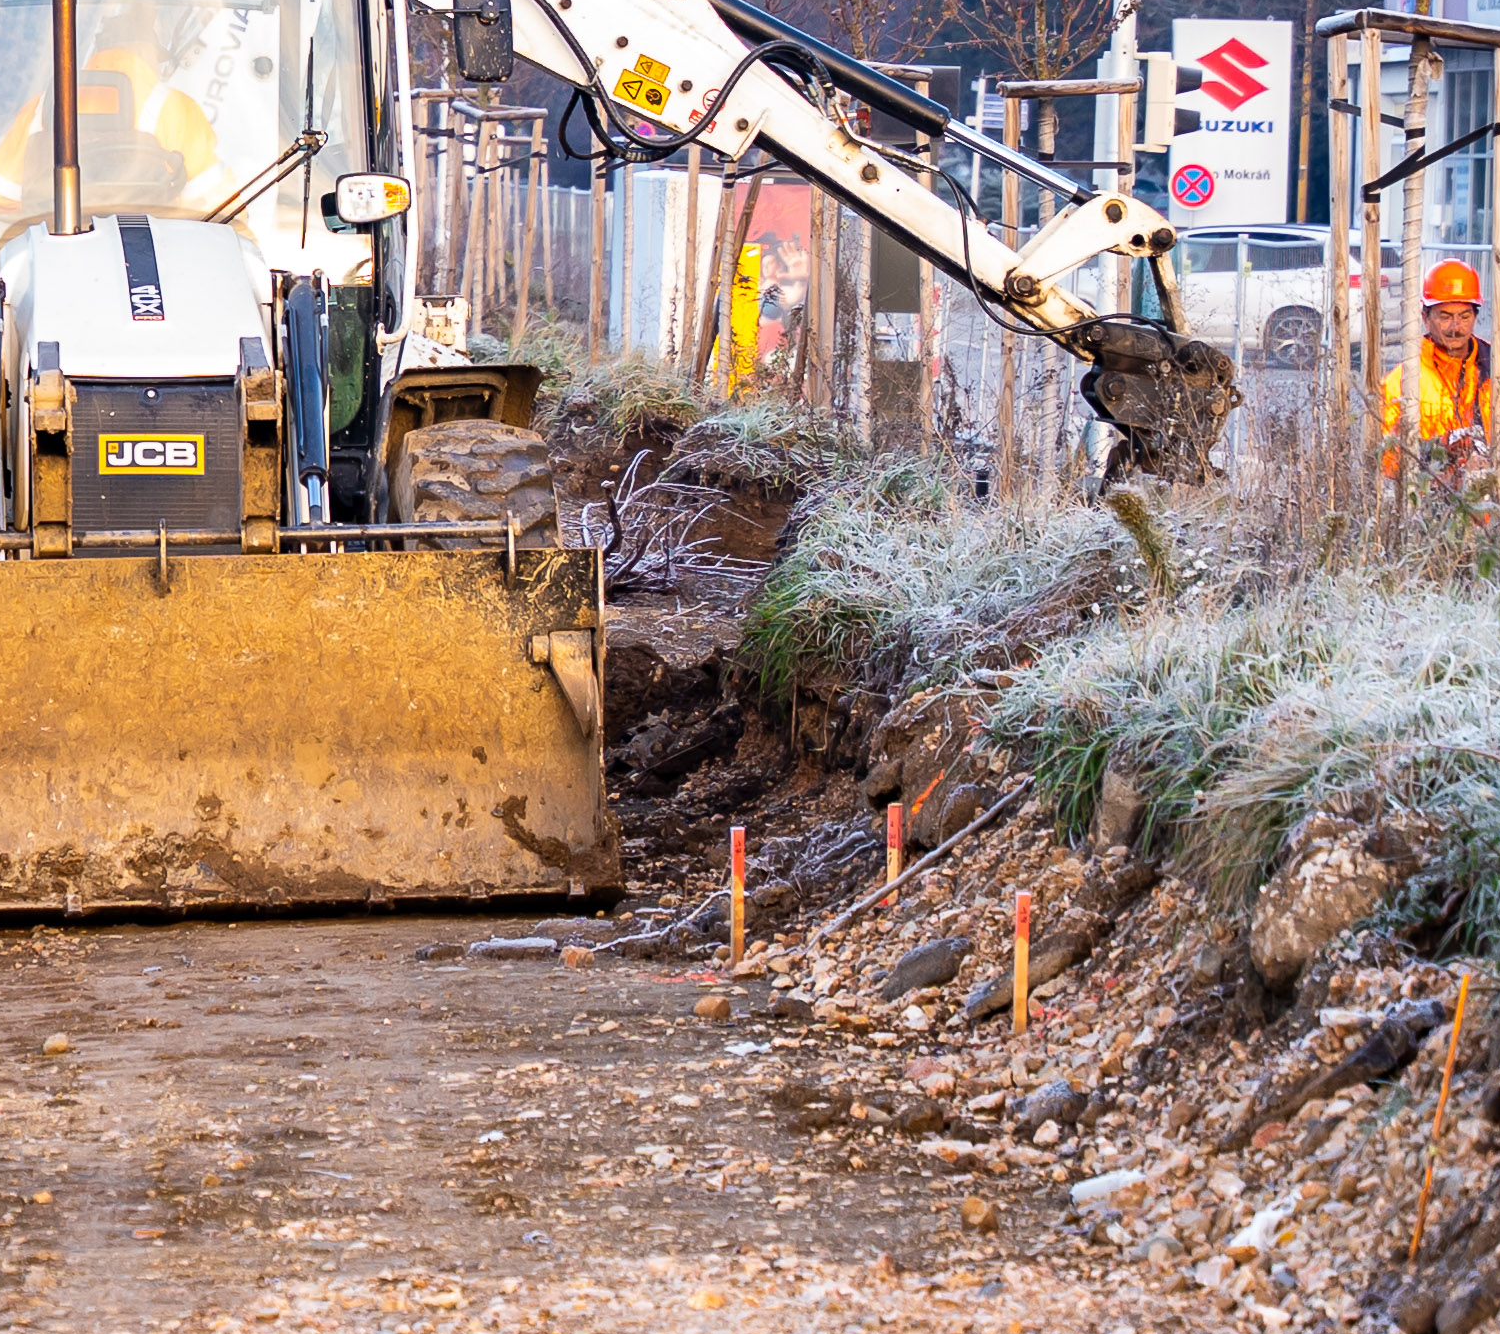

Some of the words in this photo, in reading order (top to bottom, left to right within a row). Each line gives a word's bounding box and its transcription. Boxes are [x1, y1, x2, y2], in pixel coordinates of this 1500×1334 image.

[1199, 120, 1273, 133] UZUKI
[1223, 169, 1271, 180] Mokráň
[107, 441, 197, 466] JCB
